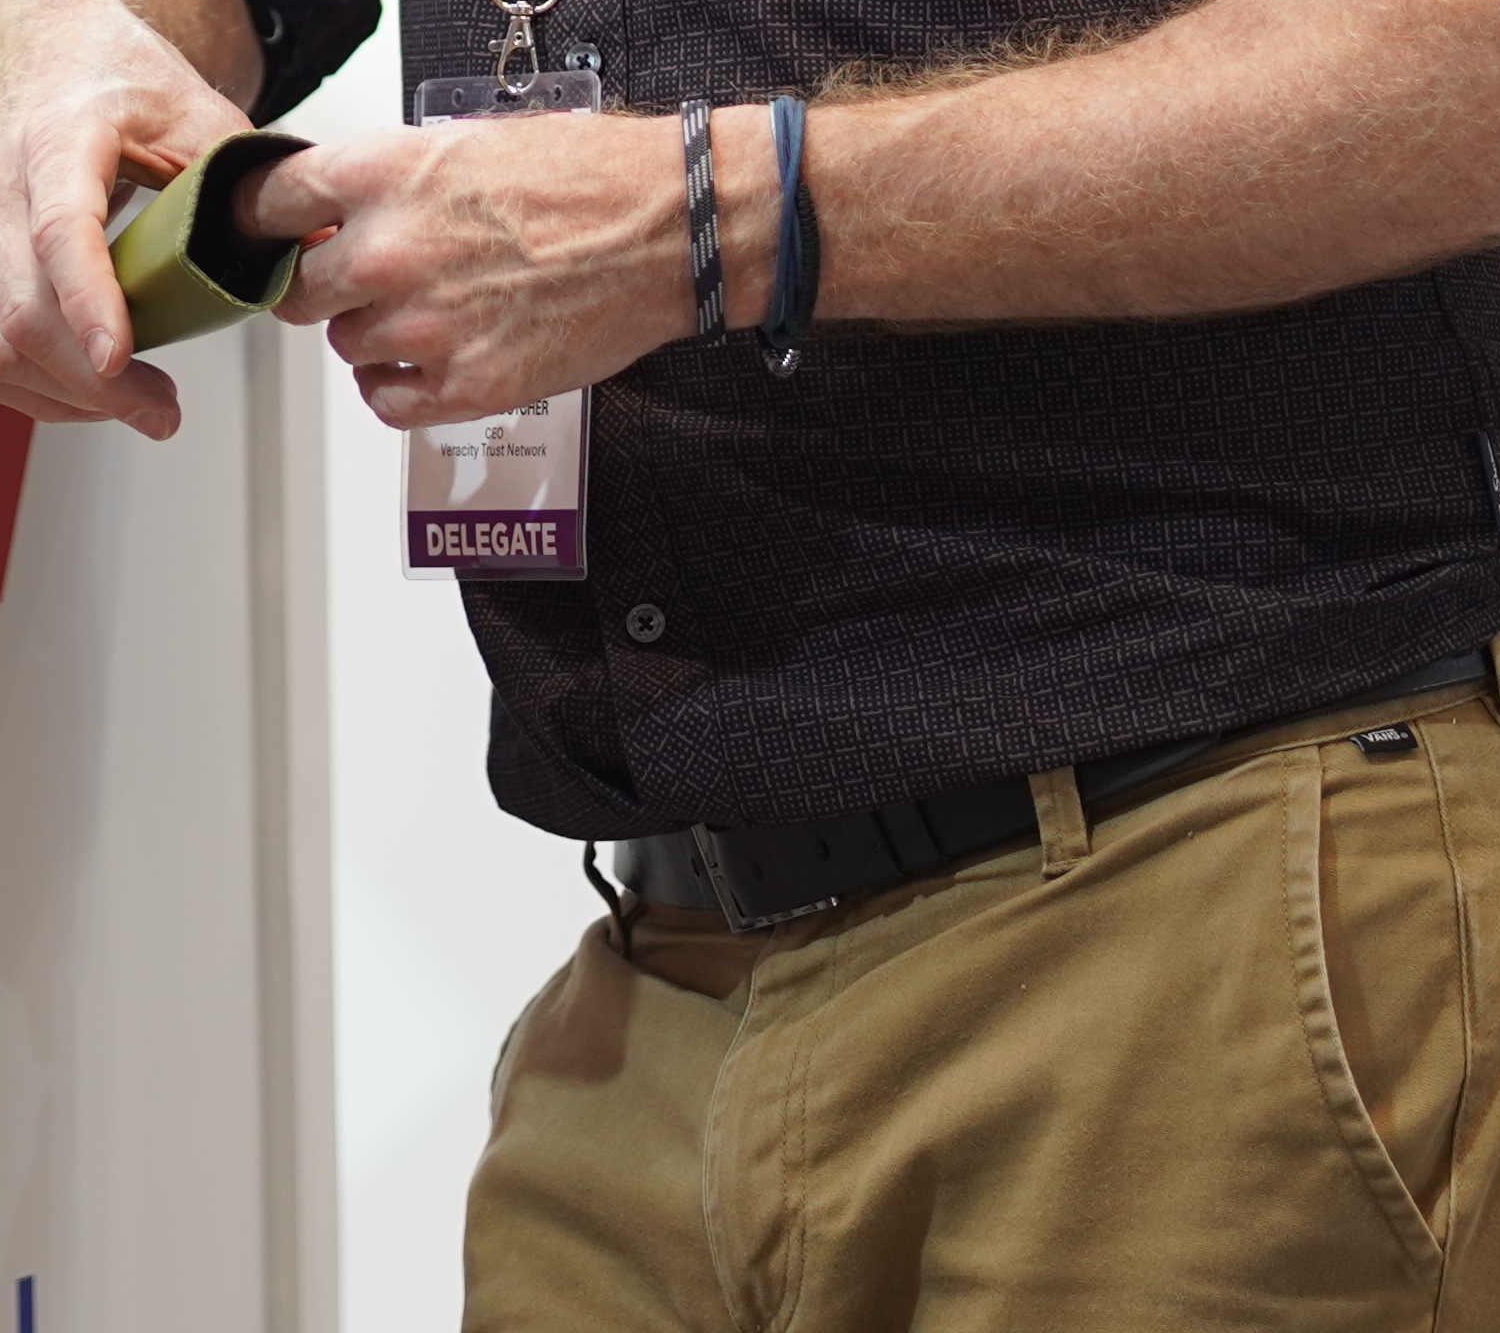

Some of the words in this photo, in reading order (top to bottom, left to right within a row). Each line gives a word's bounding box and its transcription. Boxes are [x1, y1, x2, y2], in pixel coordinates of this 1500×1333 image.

[485, 427, 504, 440] CEO
[440, 443, 479, 460] Veracity
[481, 443, 504, 457] Trust
[507, 443, 548, 457] Network
[426, 521, 558, 557] DELEGATE
